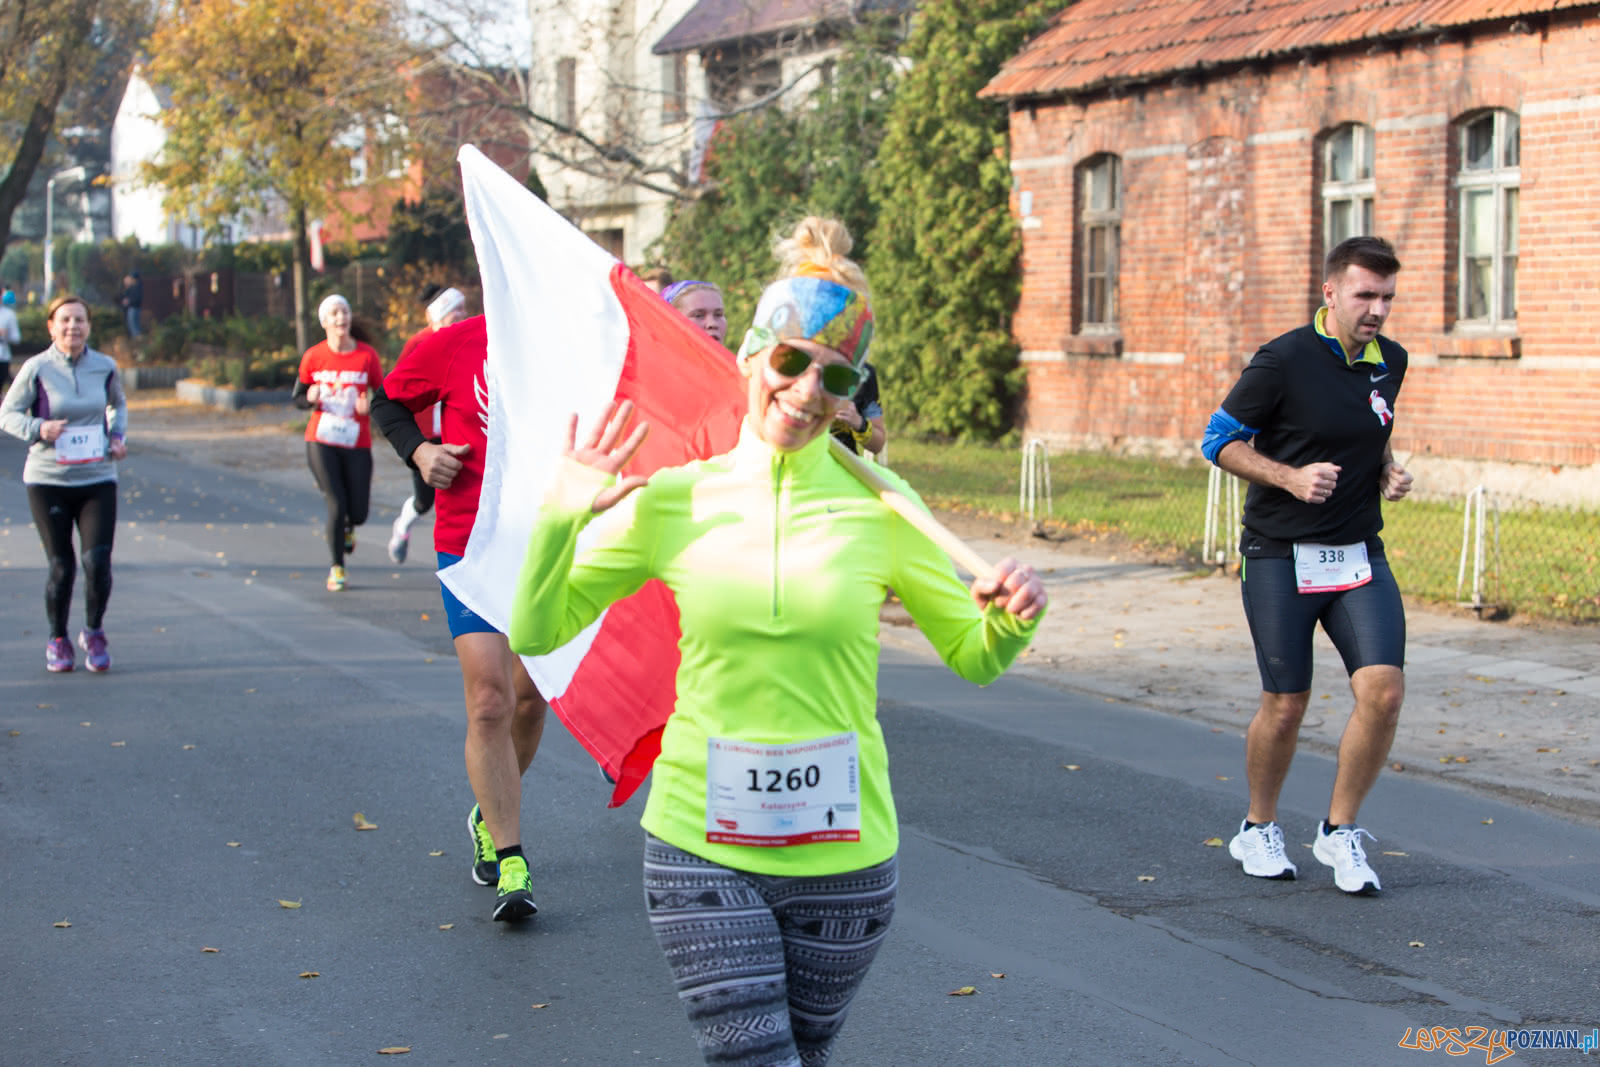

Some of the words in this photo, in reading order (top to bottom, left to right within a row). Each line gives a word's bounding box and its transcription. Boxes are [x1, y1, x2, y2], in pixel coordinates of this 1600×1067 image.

[71, 434, 89, 445] 457
[1319, 549, 1345, 563] 338
[747, 764, 820, 792] 1260
